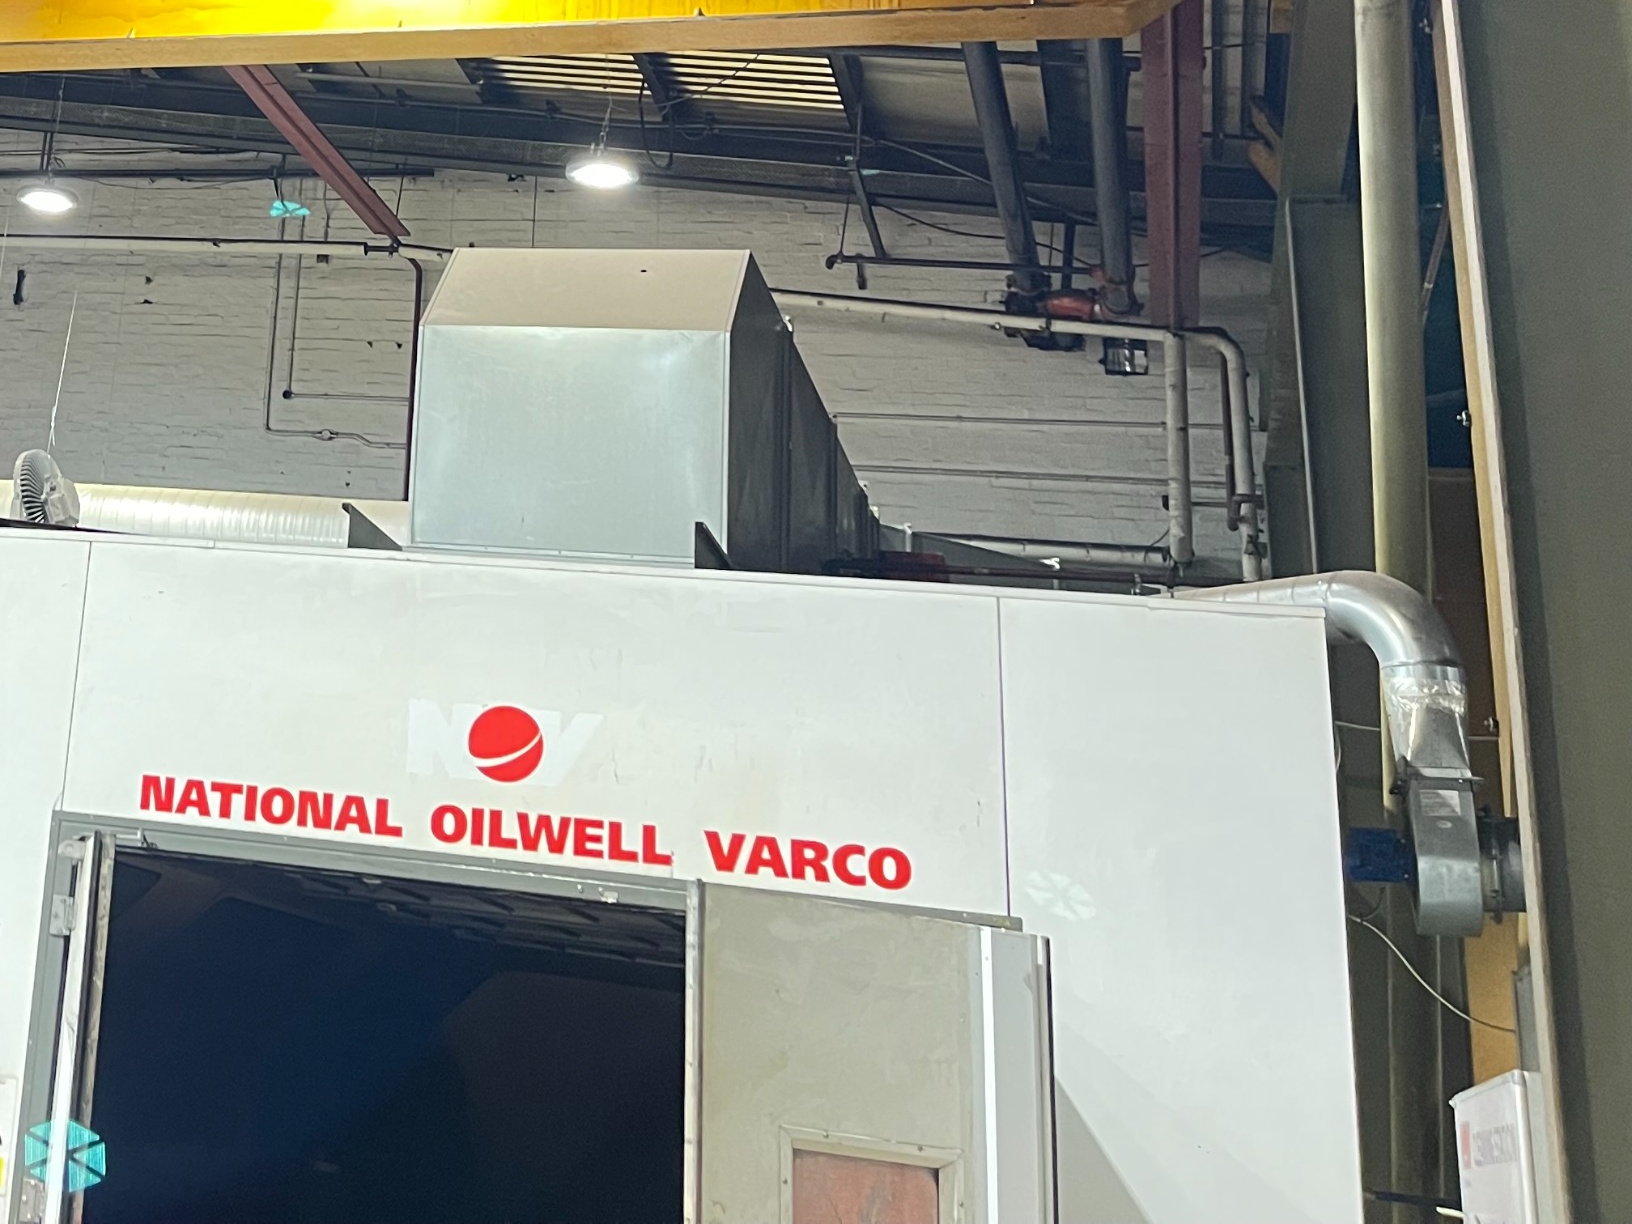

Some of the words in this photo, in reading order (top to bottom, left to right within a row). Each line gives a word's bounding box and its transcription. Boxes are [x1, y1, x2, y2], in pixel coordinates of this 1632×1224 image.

[140, 774, 402, 838] NATIONAL
[430, 804, 673, 866] OILWELL
[704, 830, 912, 890] VARCO
